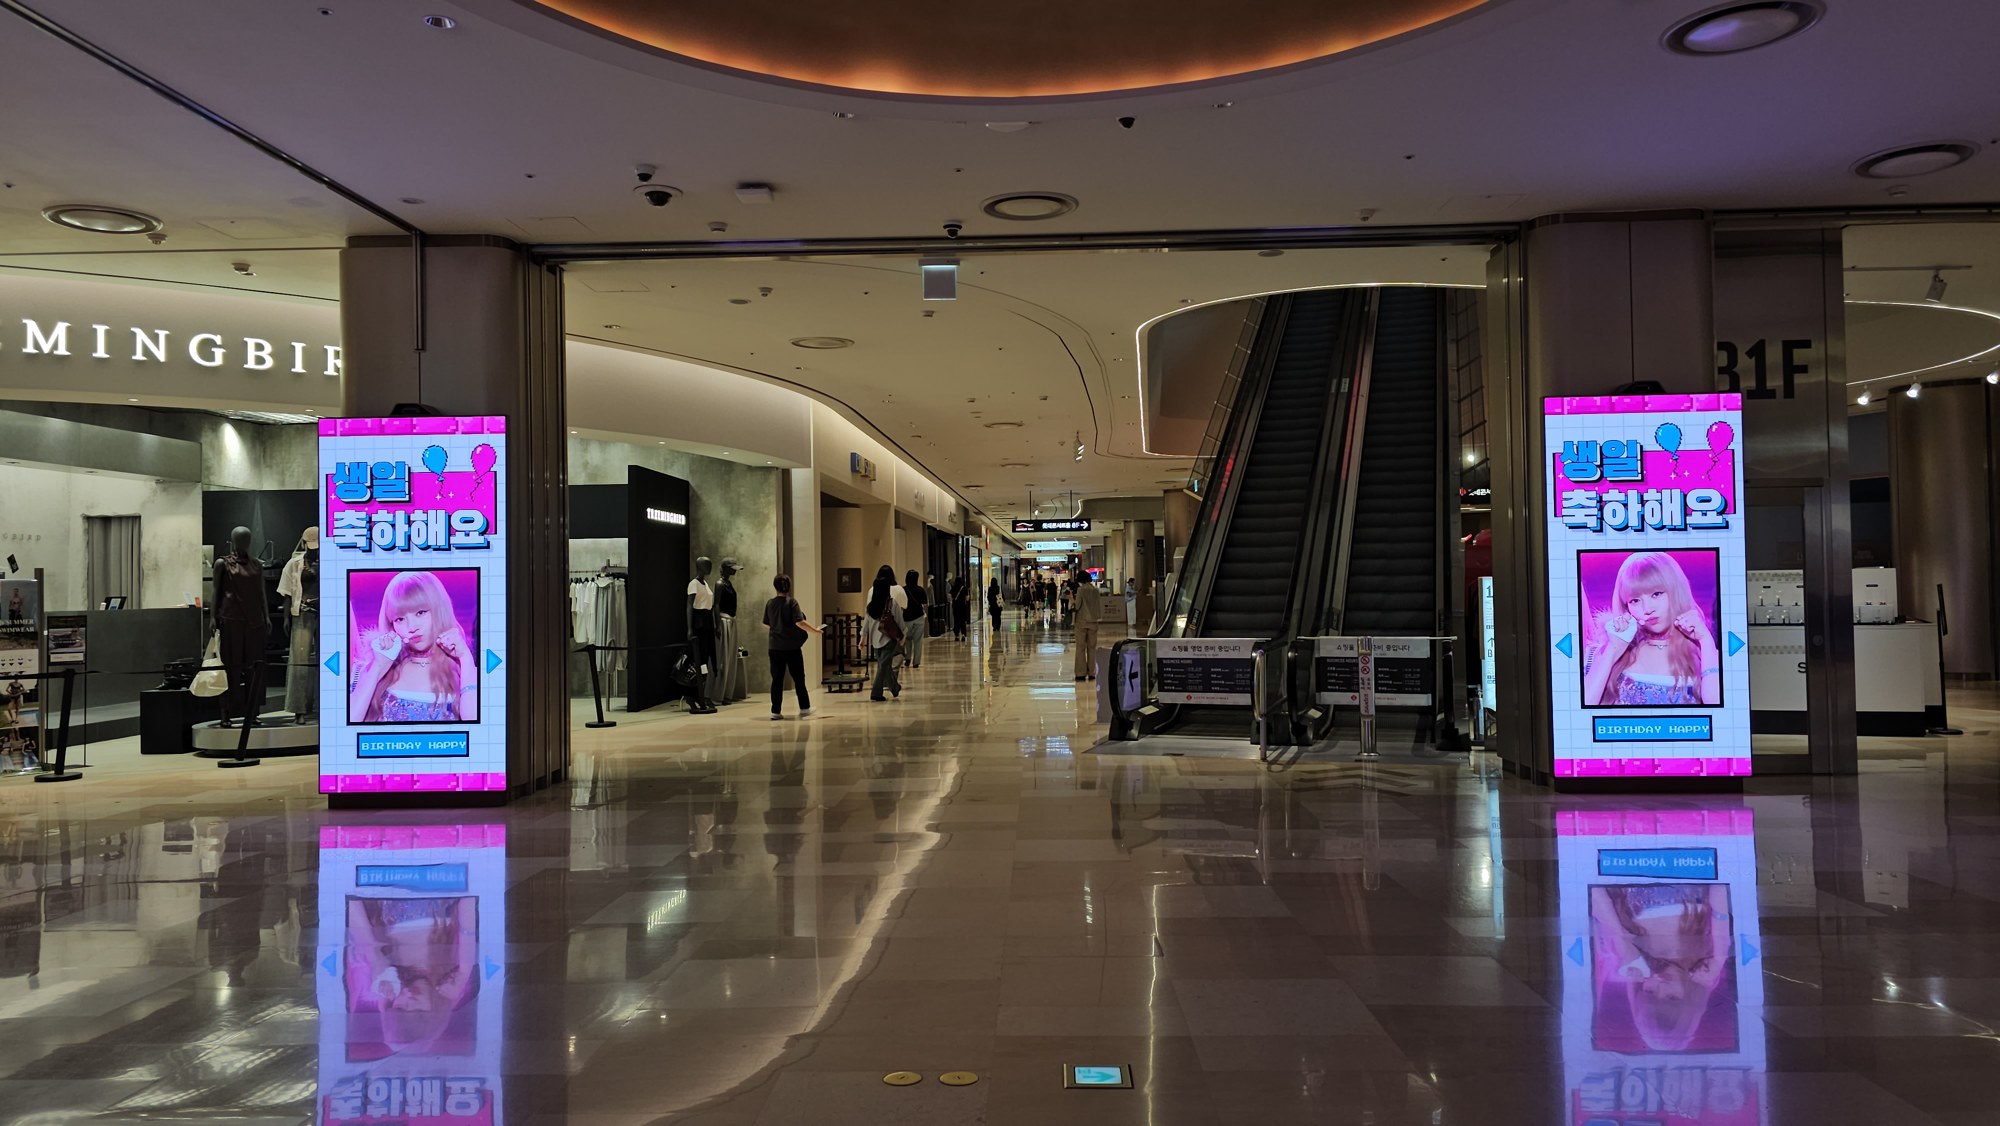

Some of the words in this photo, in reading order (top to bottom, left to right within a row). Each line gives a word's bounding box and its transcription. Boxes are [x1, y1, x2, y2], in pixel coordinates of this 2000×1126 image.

[0, 318, 340, 376] MINGBIR
[1560, 440, 1642, 480] 생일
[332, 461, 410, 502] 생일
[1562, 488, 1728, 531] 축하해요
[333, 509, 489, 551] 축하해요
[1797, 662, 1807, 674] S
[361, 741, 421, 750] BIRTHDAY
[428, 741, 466, 749] HAPPY
[1598, 725, 1661, 734] BIRTHDAY
[1669, 725, 1709, 733] HAPPY
